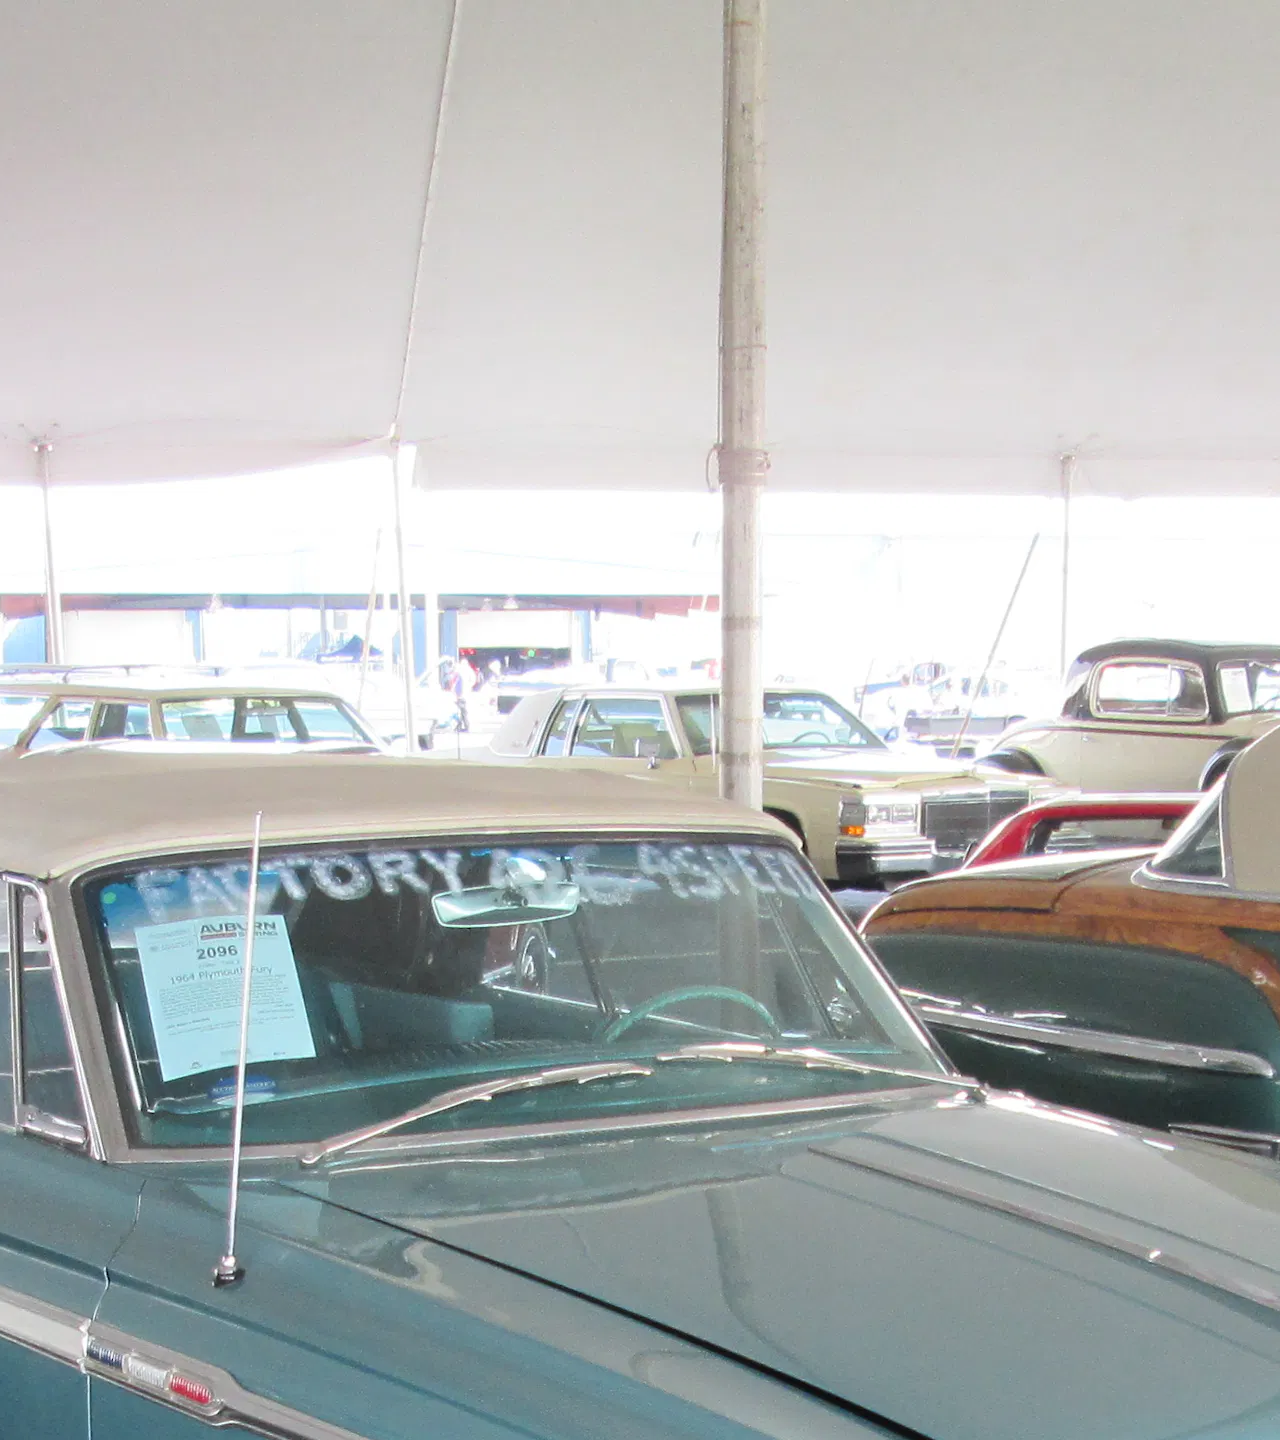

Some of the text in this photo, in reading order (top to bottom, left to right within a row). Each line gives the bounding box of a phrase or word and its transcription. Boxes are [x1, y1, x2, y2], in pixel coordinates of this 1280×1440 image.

[136, 848, 463, 925] FACTORY
[200, 921, 277, 934] AUBURN
[196, 944, 238, 960] 2096
[170, 973, 195, 985] 1964
